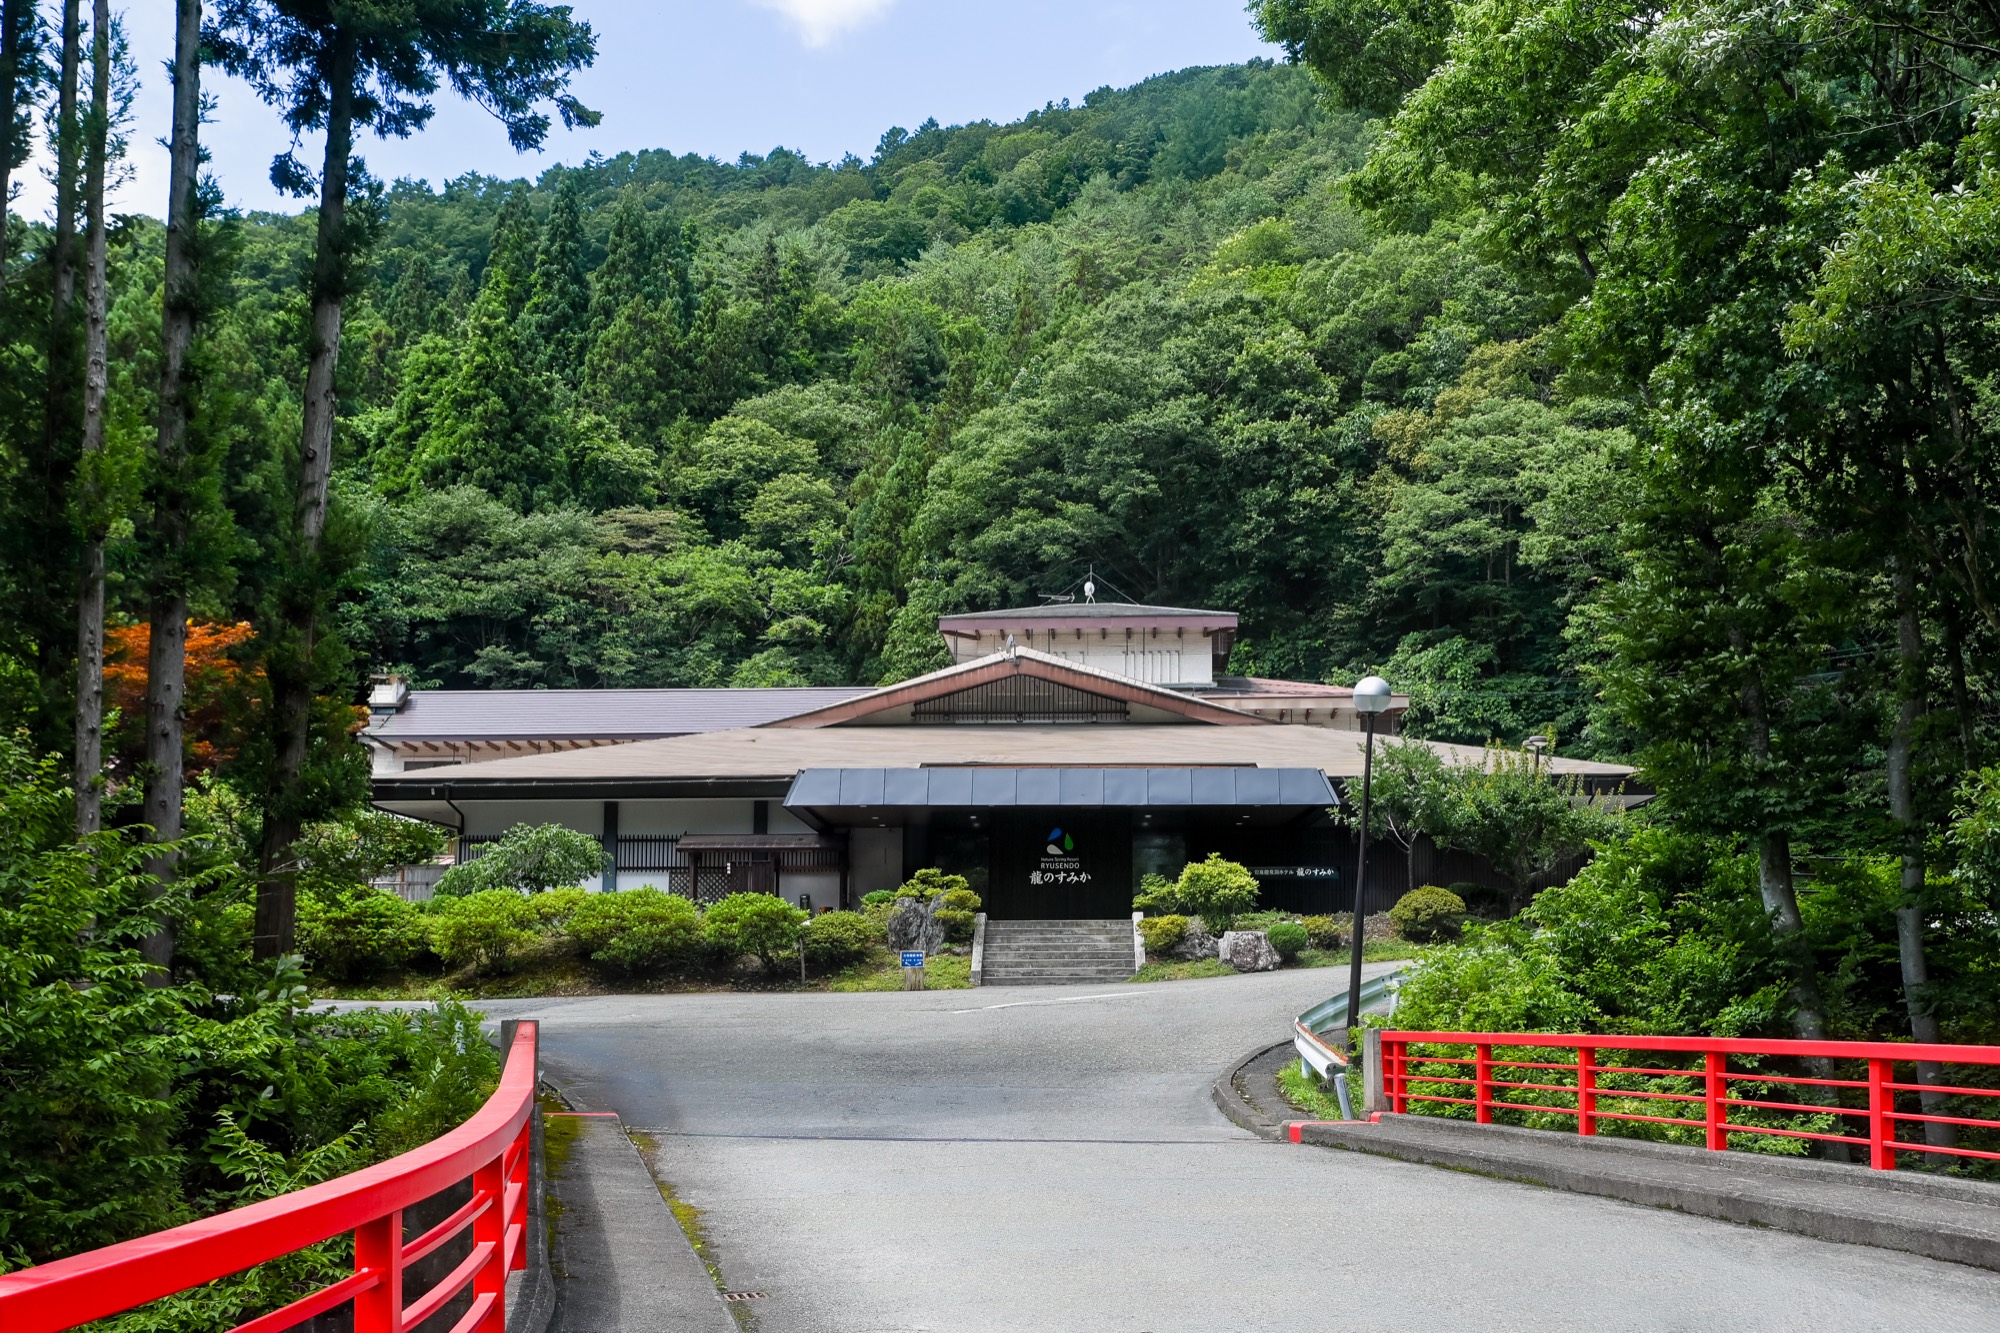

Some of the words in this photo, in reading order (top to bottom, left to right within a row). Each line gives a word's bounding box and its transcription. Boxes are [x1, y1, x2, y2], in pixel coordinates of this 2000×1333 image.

[1029, 870, 1092, 885] 龍のすみか
[1296, 868, 1334, 877] 龍のすみか
